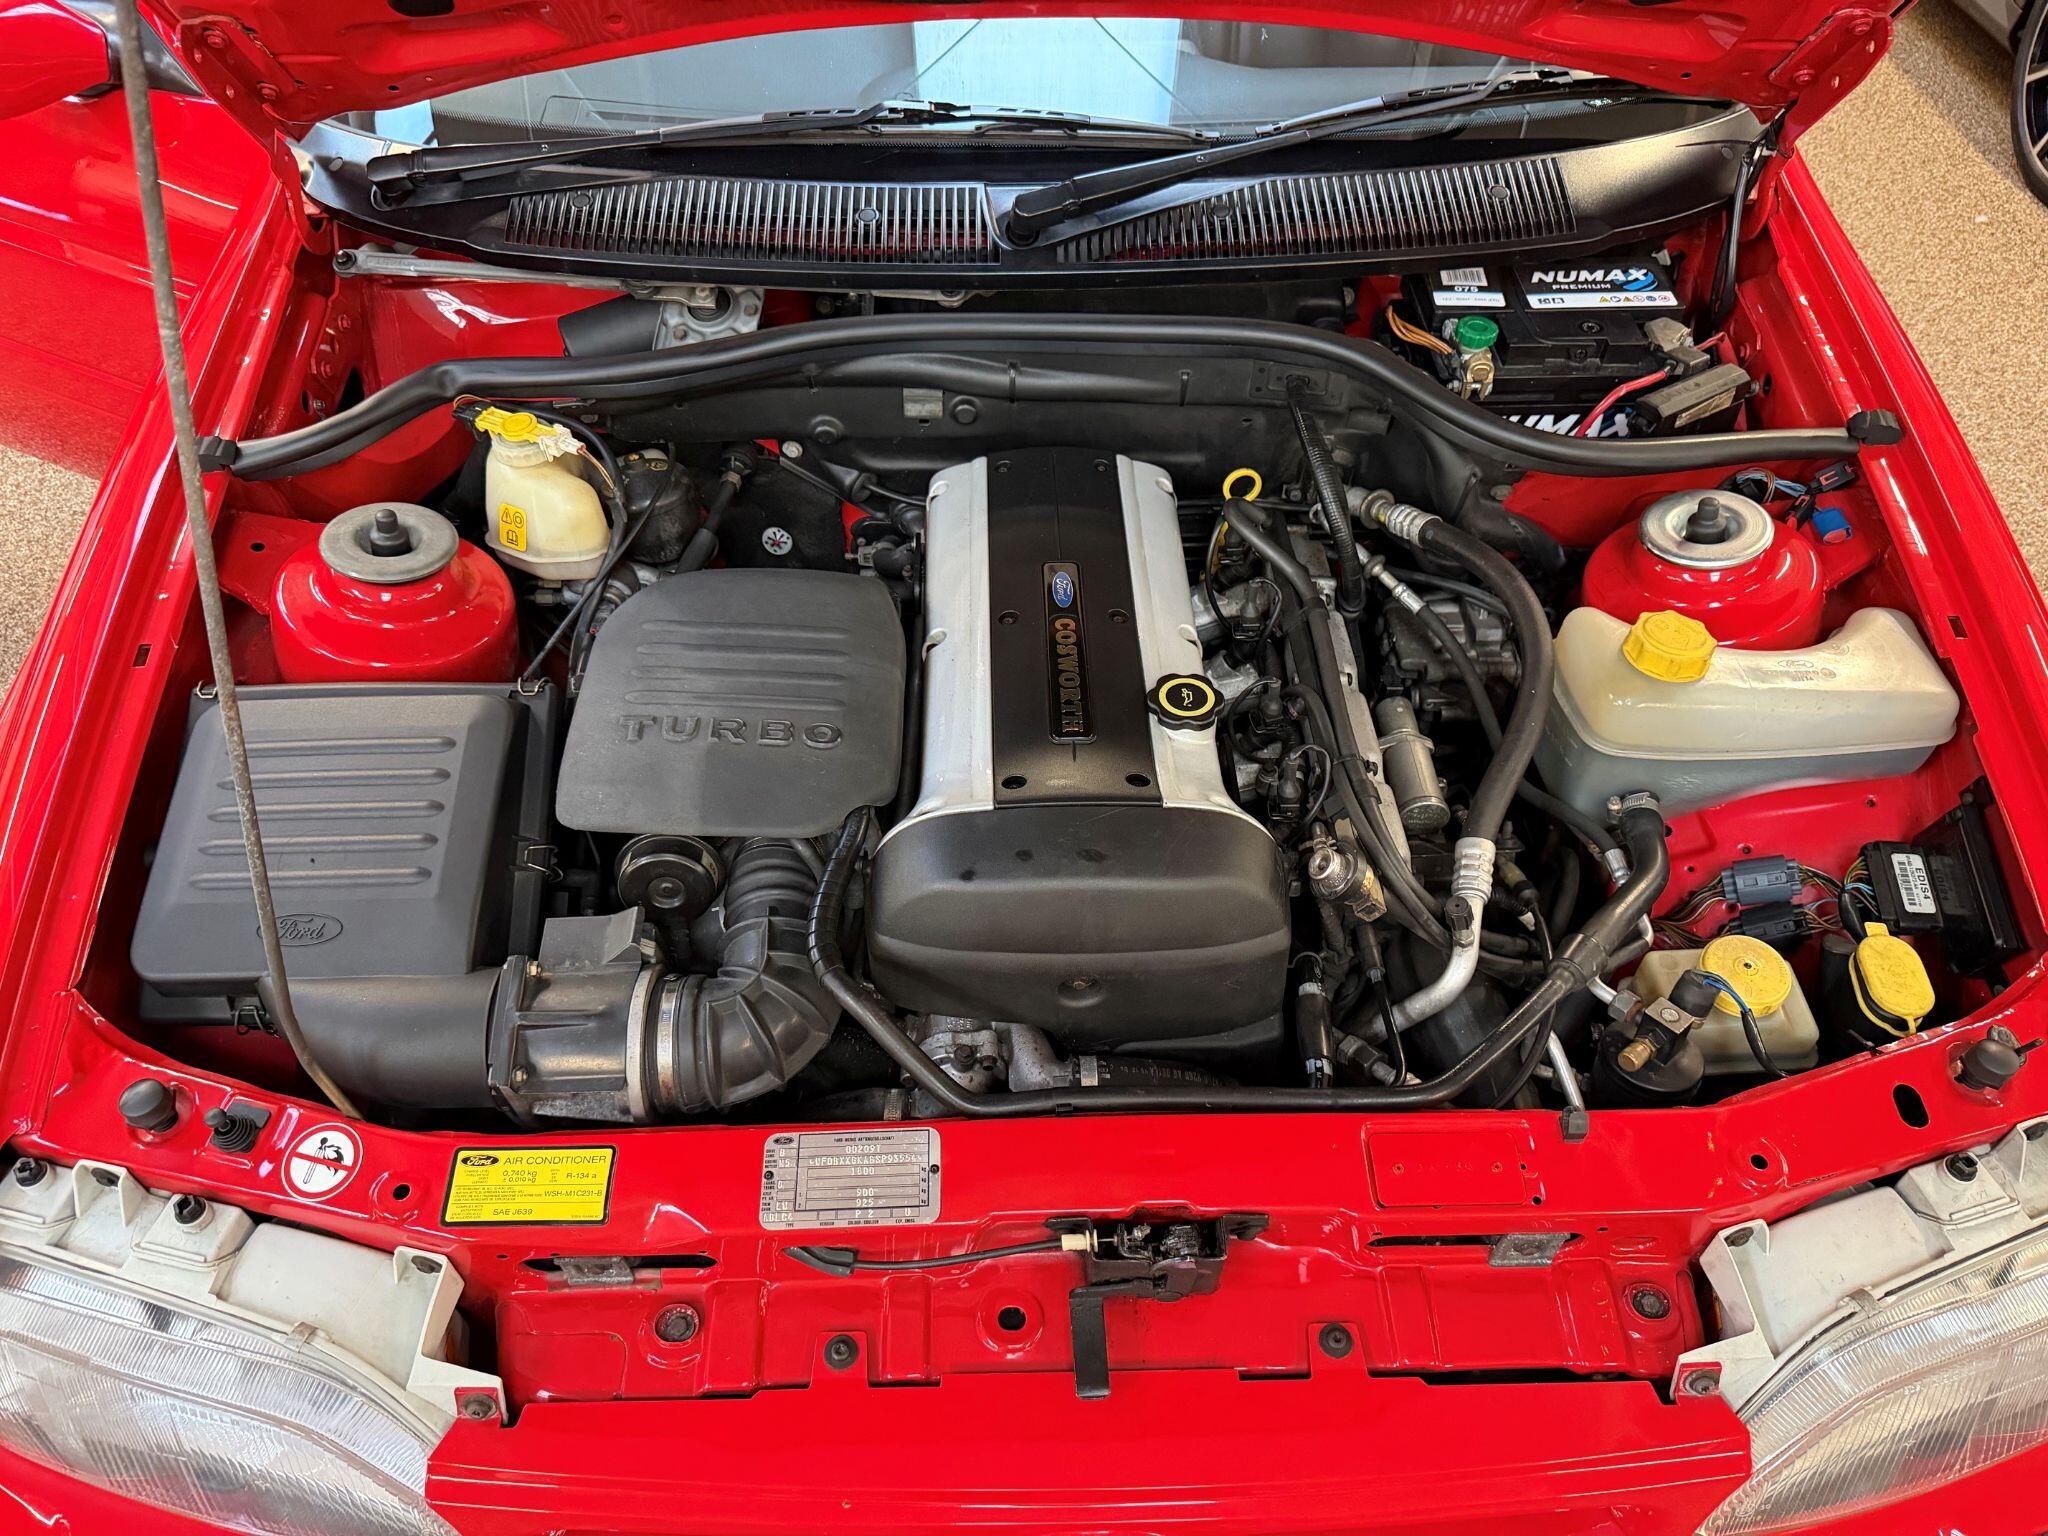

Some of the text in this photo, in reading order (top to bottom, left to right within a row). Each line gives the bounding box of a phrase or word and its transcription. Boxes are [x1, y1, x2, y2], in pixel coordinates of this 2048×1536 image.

[1531, 268, 1648, 283] NUMAX
[1552, 283, 1611, 291] PREMIUM
[1055, 575, 1072, 602] Ford
[1055, 618, 1083, 732] COSWORTH
[619, 714, 844, 749] TURBO
[1915, 867, 1931, 900] EDIS4
[278, 917, 327, 940] Ford
[464, 1155, 496, 1166] Ford
[504, 1155, 607, 1165] AIR CONDITIONER
[527, 1170, 538, 1178] kg
[856, 1188, 874, 1197] 900
[856, 1198, 874, 1207] 925
[492, 1208, 511, 1216] SAE
